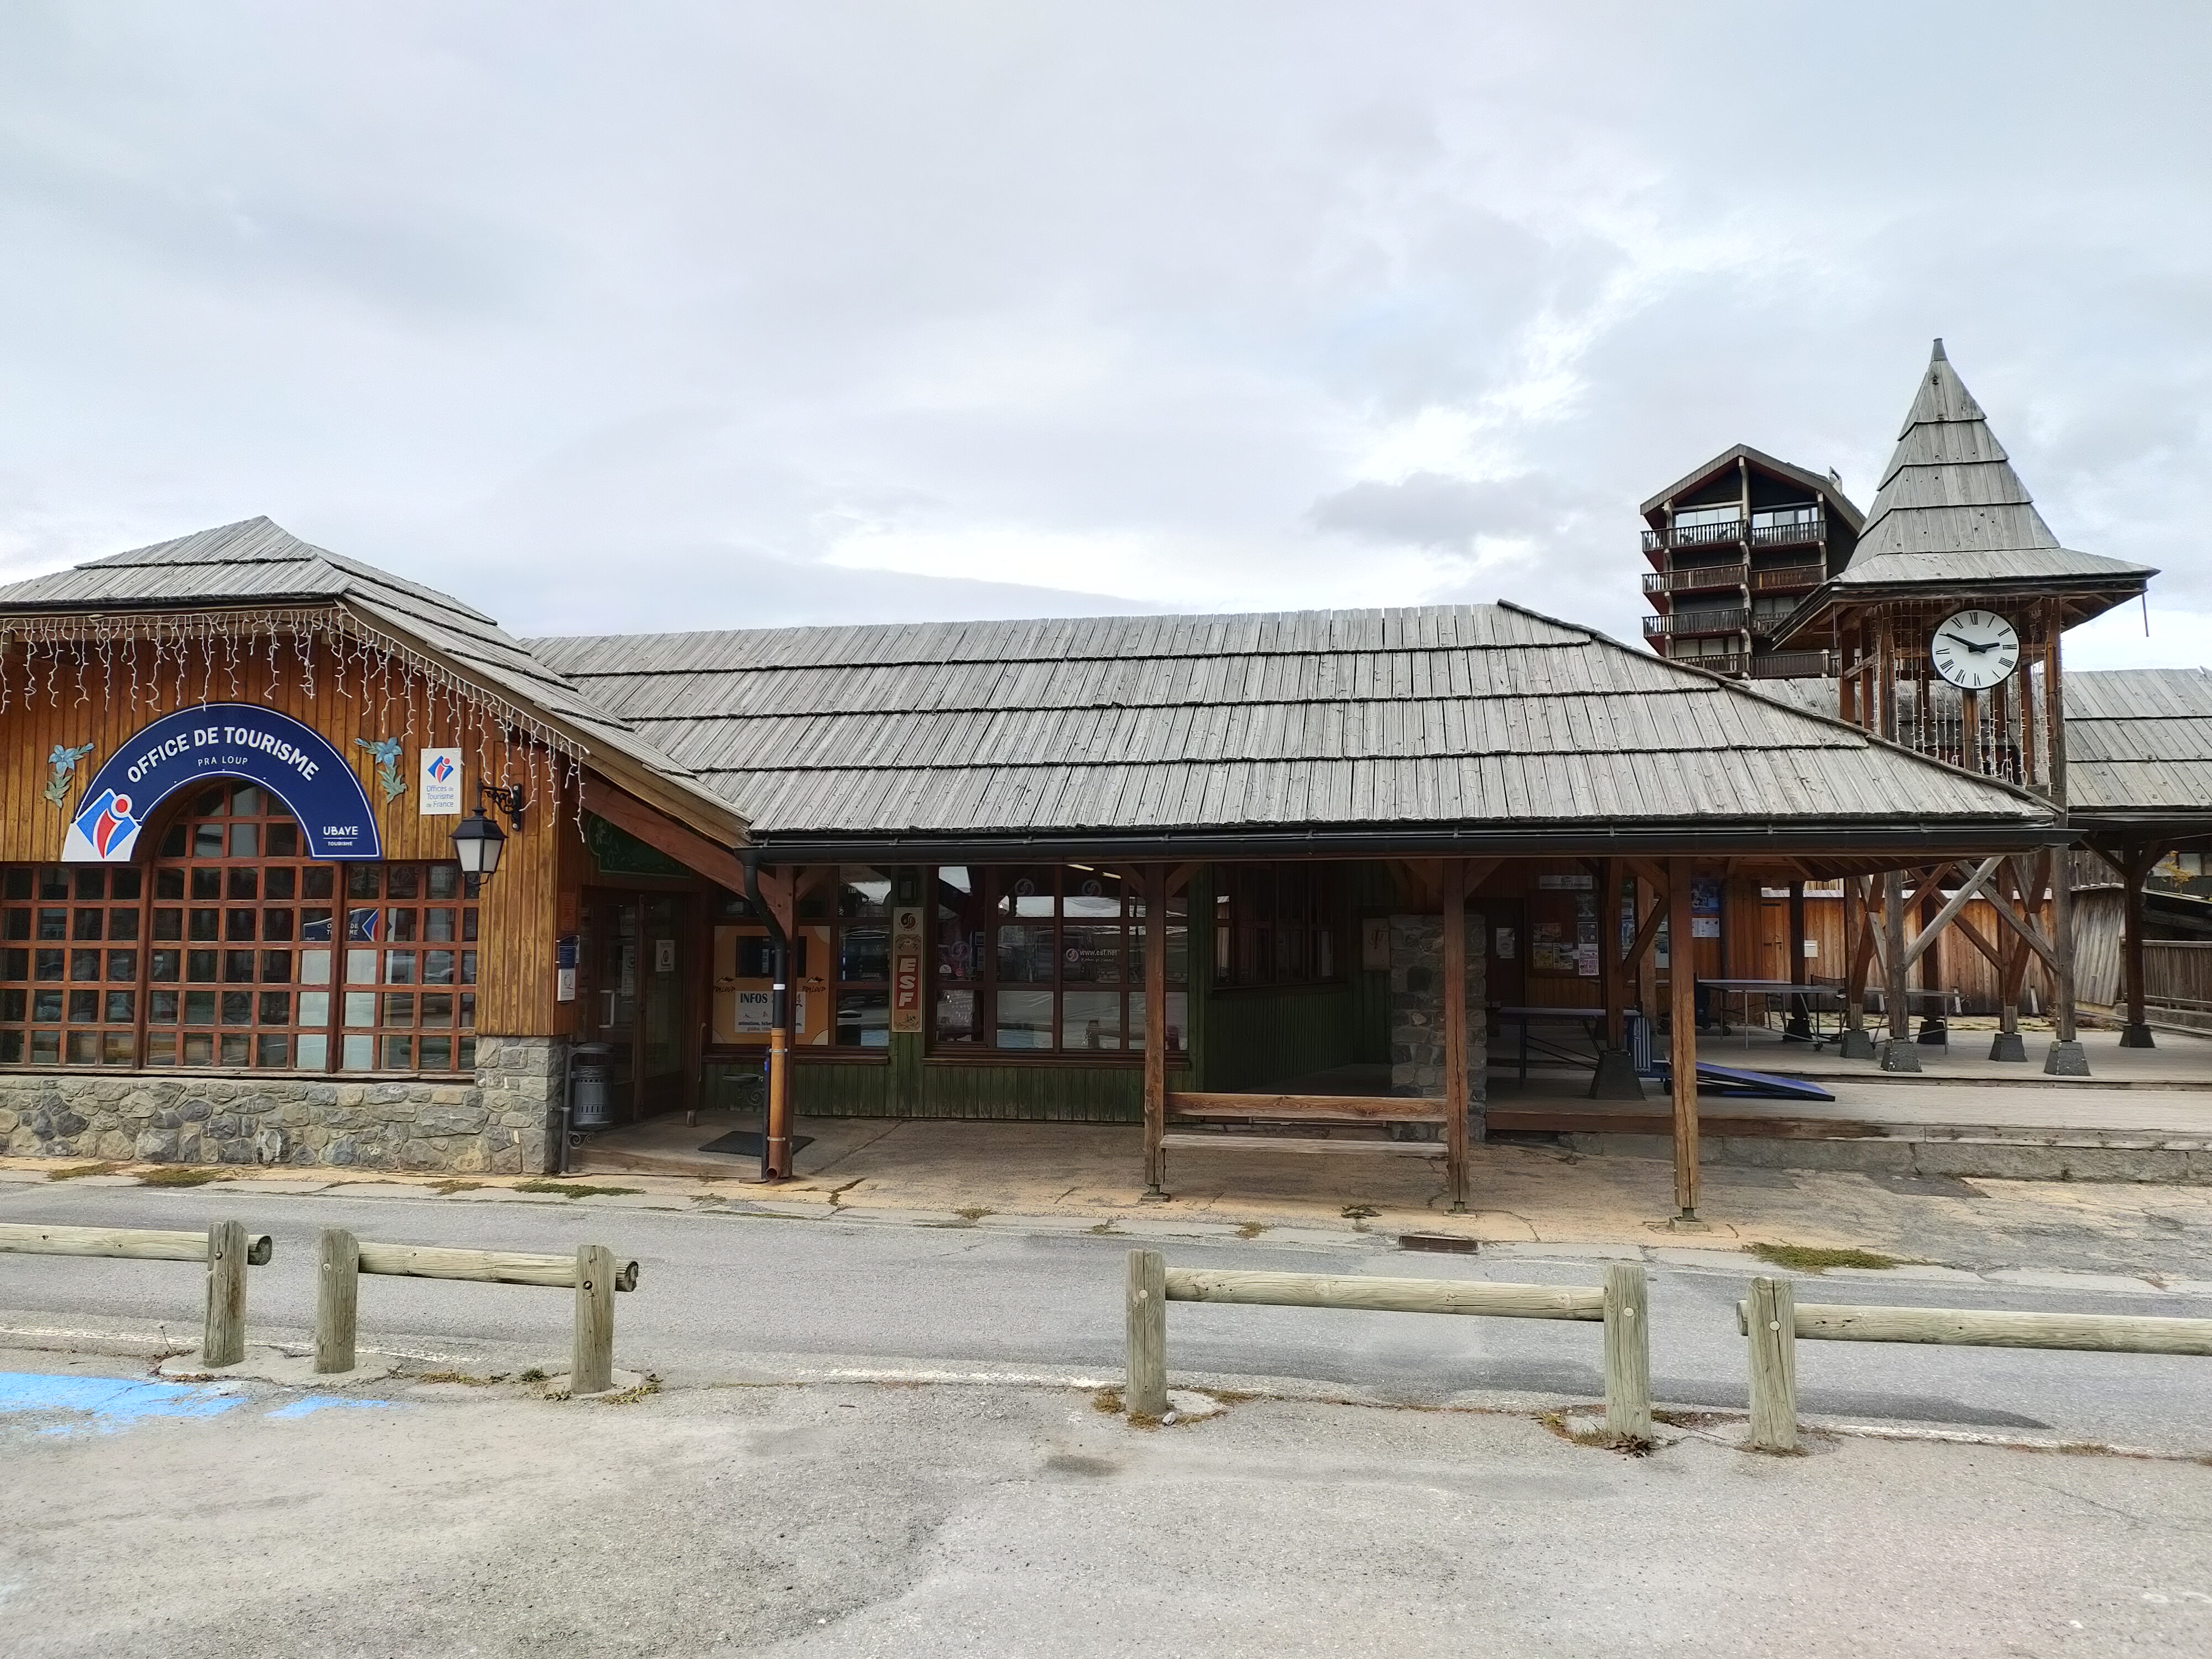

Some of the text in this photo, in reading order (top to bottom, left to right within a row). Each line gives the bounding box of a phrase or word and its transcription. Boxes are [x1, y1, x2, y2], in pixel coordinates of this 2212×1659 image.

[127, 726, 320, 783] OFFICE DE TOURISME
[197, 755, 248, 767] PRA LOUP
[323, 826, 358, 836] UBAYE
[899, 958, 916, 1007] ESF
[740, 993, 768, 1004] INFOS
